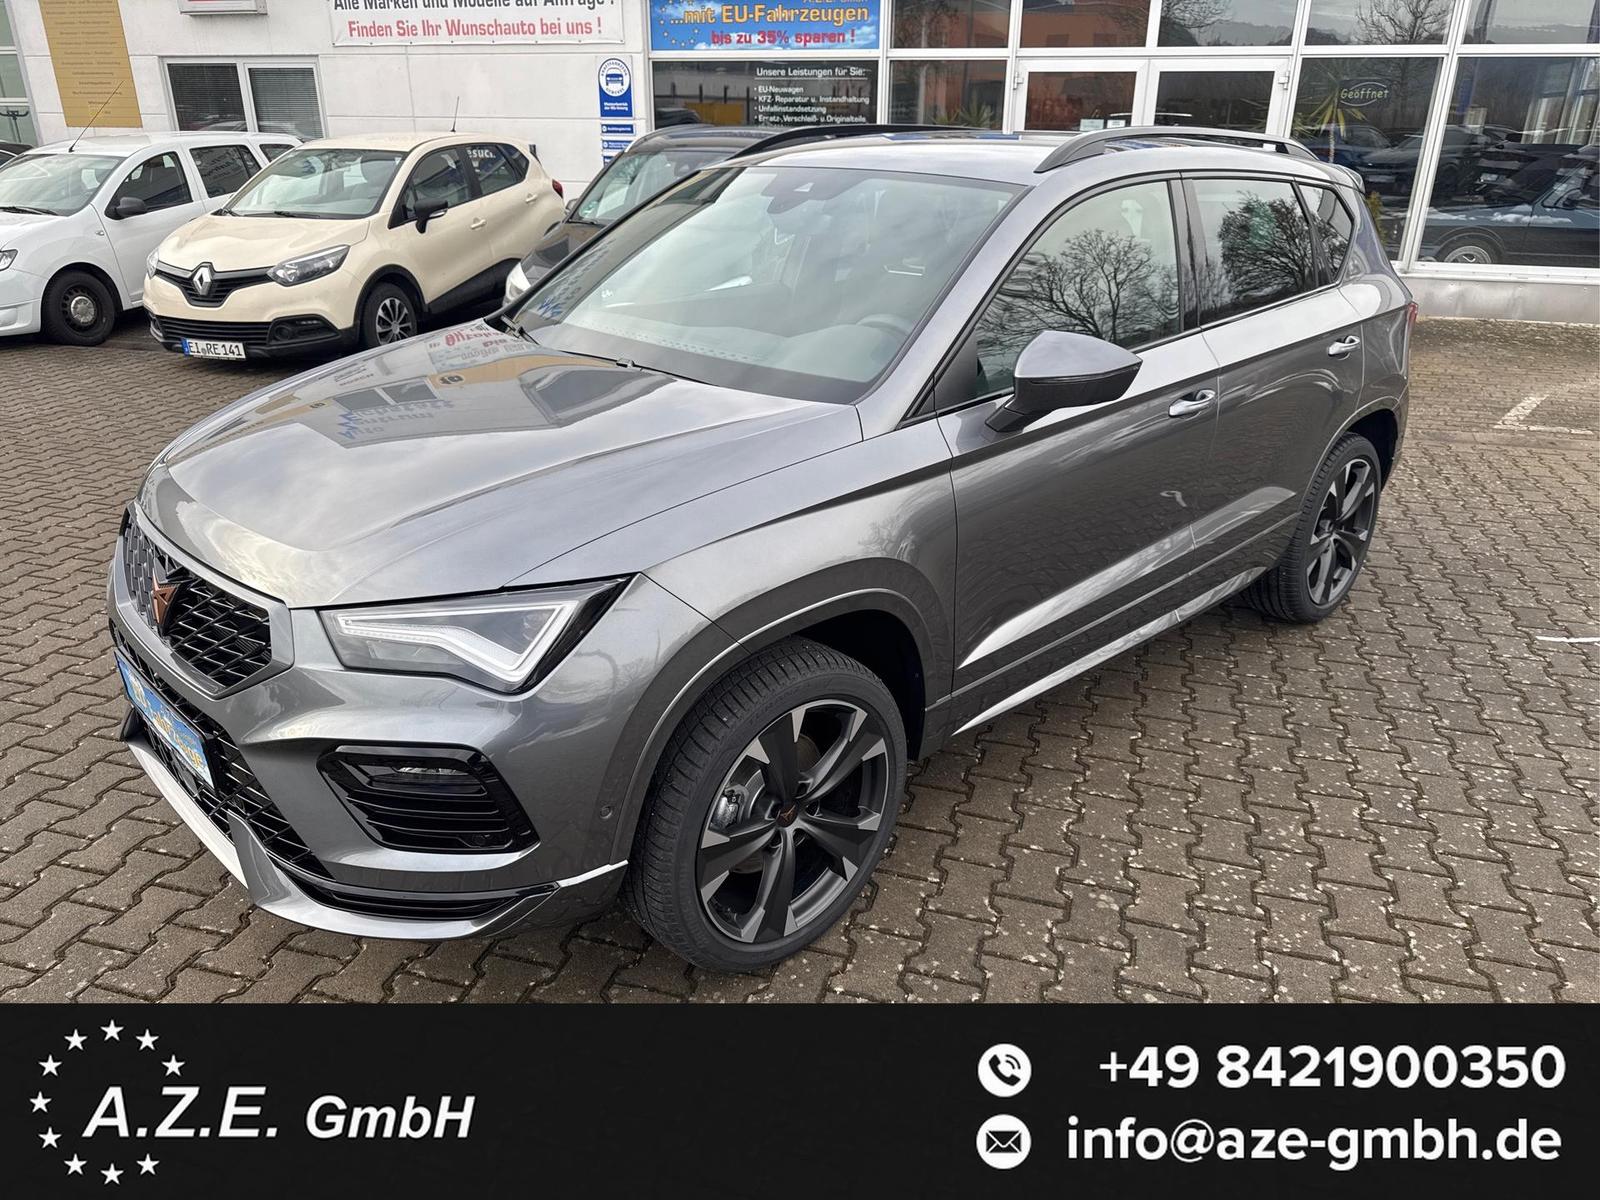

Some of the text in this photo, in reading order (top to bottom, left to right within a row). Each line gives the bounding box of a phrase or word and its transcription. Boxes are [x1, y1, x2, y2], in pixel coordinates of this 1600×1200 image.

[721, 4, 869, 26] EU-Fahrzeugen
[348, 20, 393, 37] Finden
[396, 19, 418, 36] Sie
[421, 19, 442, 36] Ihr
[445, 18, 536, 36] Wunschauto
[540, 17, 561, 35] bei
[566, 20, 593, 35] uns
[711, 30, 732, 44] bis
[736, 32, 752, 44] zu
[757, 30, 790, 44] 35%
[795, 32, 846, 46] sparen
[756, 67, 786, 76] Unsere
[788, 67, 833, 78] Leistungen
[835, 67, 848, 76] für
[1340, 87, 1390, 99] Geöffnet
[189, 341, 243, 356] EI RE 141
